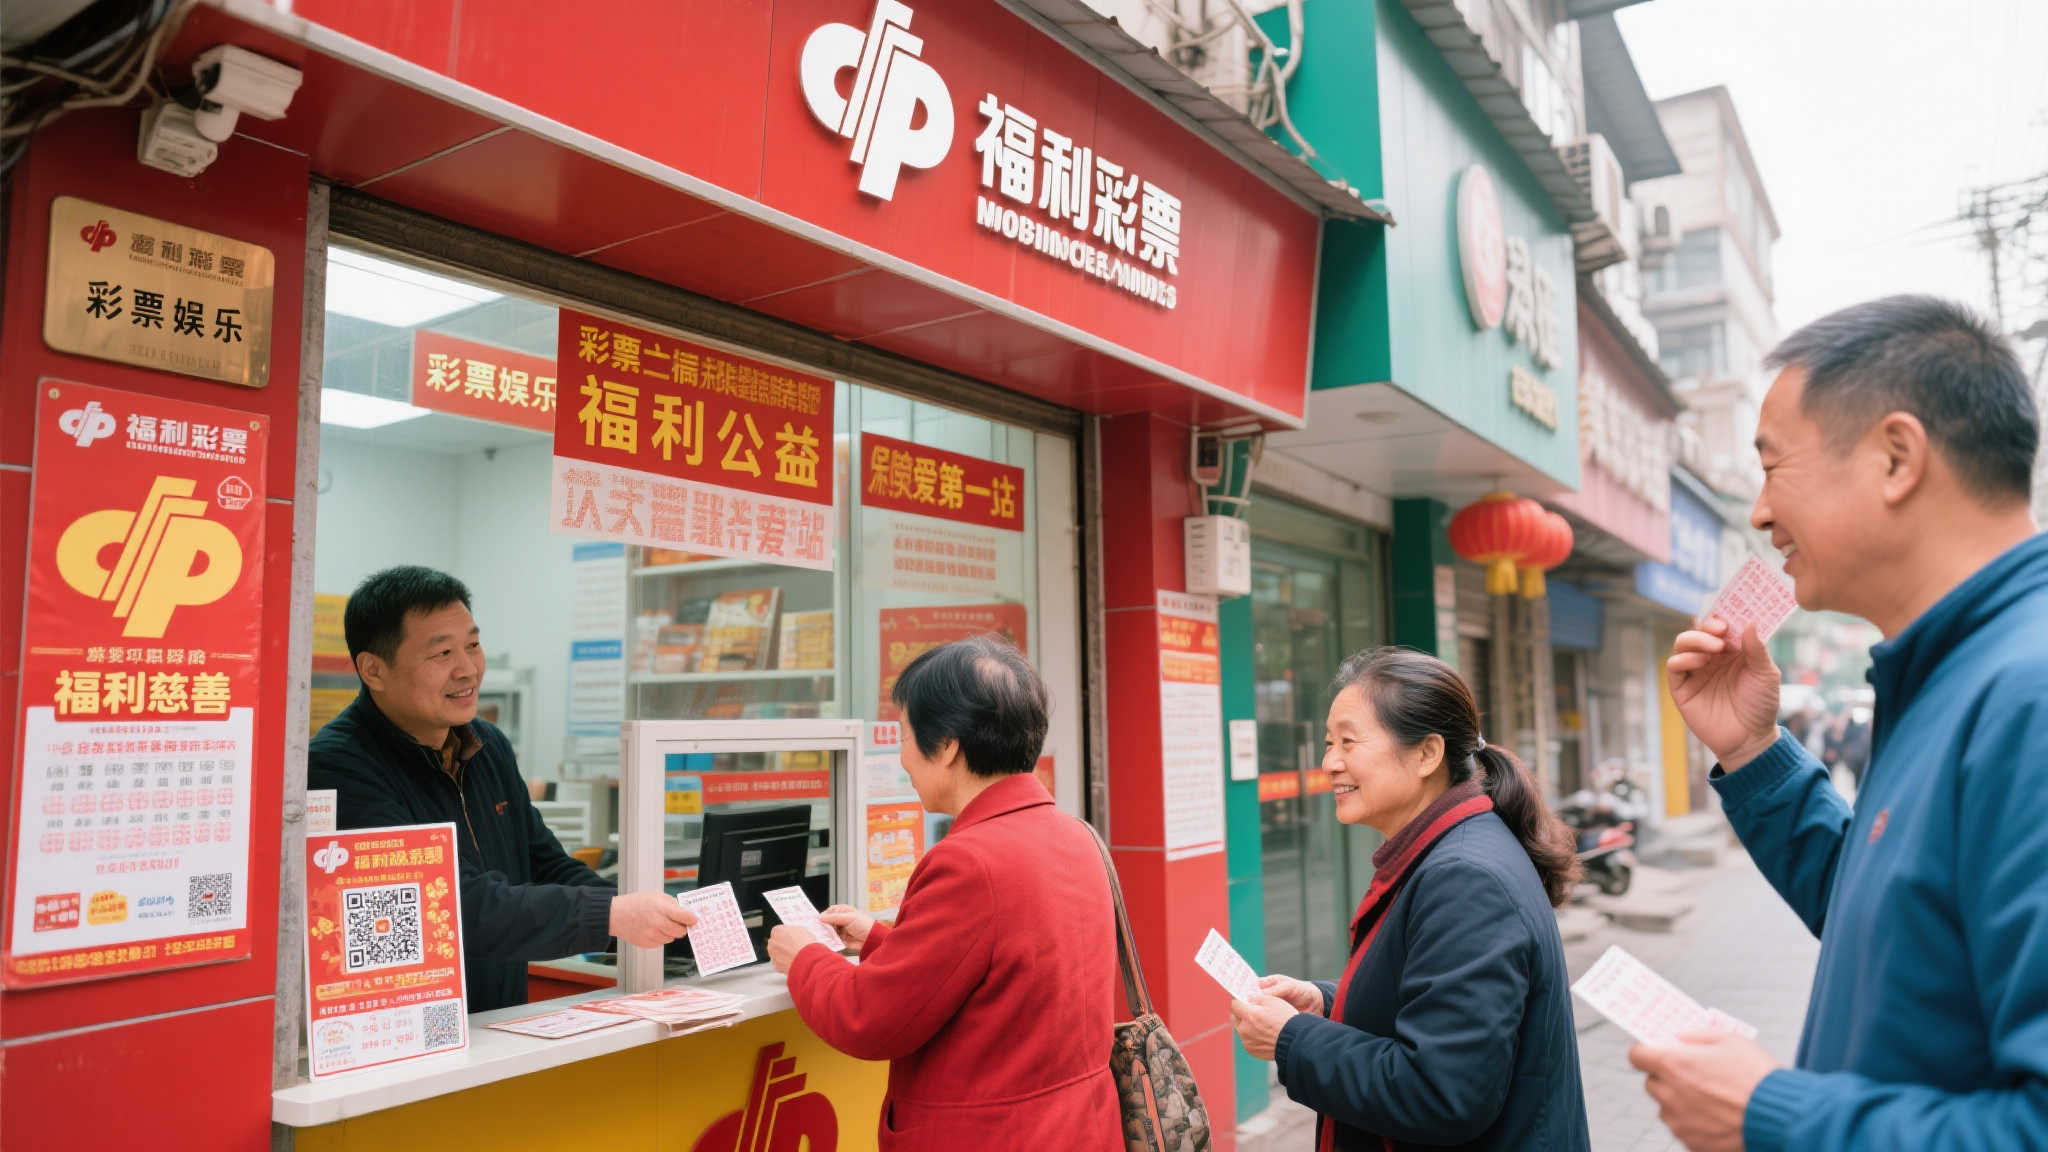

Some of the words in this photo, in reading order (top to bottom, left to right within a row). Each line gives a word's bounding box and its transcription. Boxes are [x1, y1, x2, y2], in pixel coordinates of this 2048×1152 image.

[975, 93, 1182, 276] 福利彩票
[86, 281, 243, 343] 彩票娱乐
[426, 353, 557, 413] 彩票娱乐
[126, 413, 248, 455] 福利彩票
[578, 374, 820, 488] 福利公益
[54, 670, 231, 715] 福利慈善
